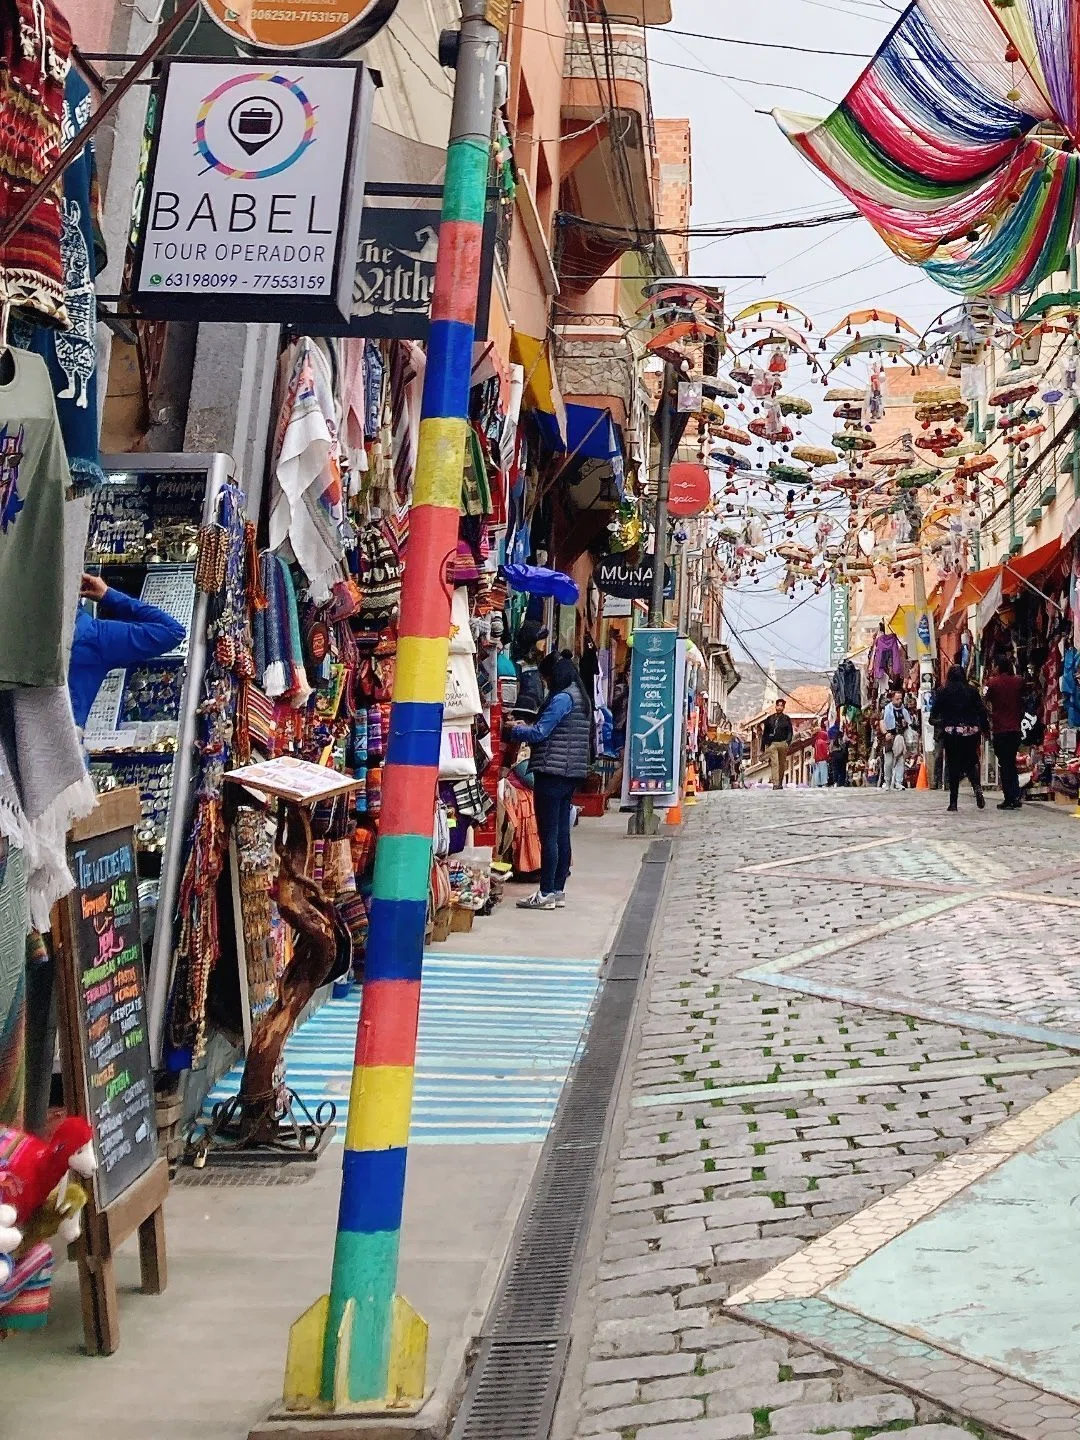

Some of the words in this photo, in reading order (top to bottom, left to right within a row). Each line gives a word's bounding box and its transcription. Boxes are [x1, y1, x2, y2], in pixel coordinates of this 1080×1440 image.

[151, 191, 332, 235] BABEL
[153, 242, 207, 260] TOUR
[215, 244, 326, 263] OPERADOR
[356, 238, 394, 263] The
[165, 273, 237, 287] 63198099
[253, 274, 325, 289] 77553159
[832, 585, 846, 653] ALOJAMIENTO
[644, 690, 661, 699] GOL
